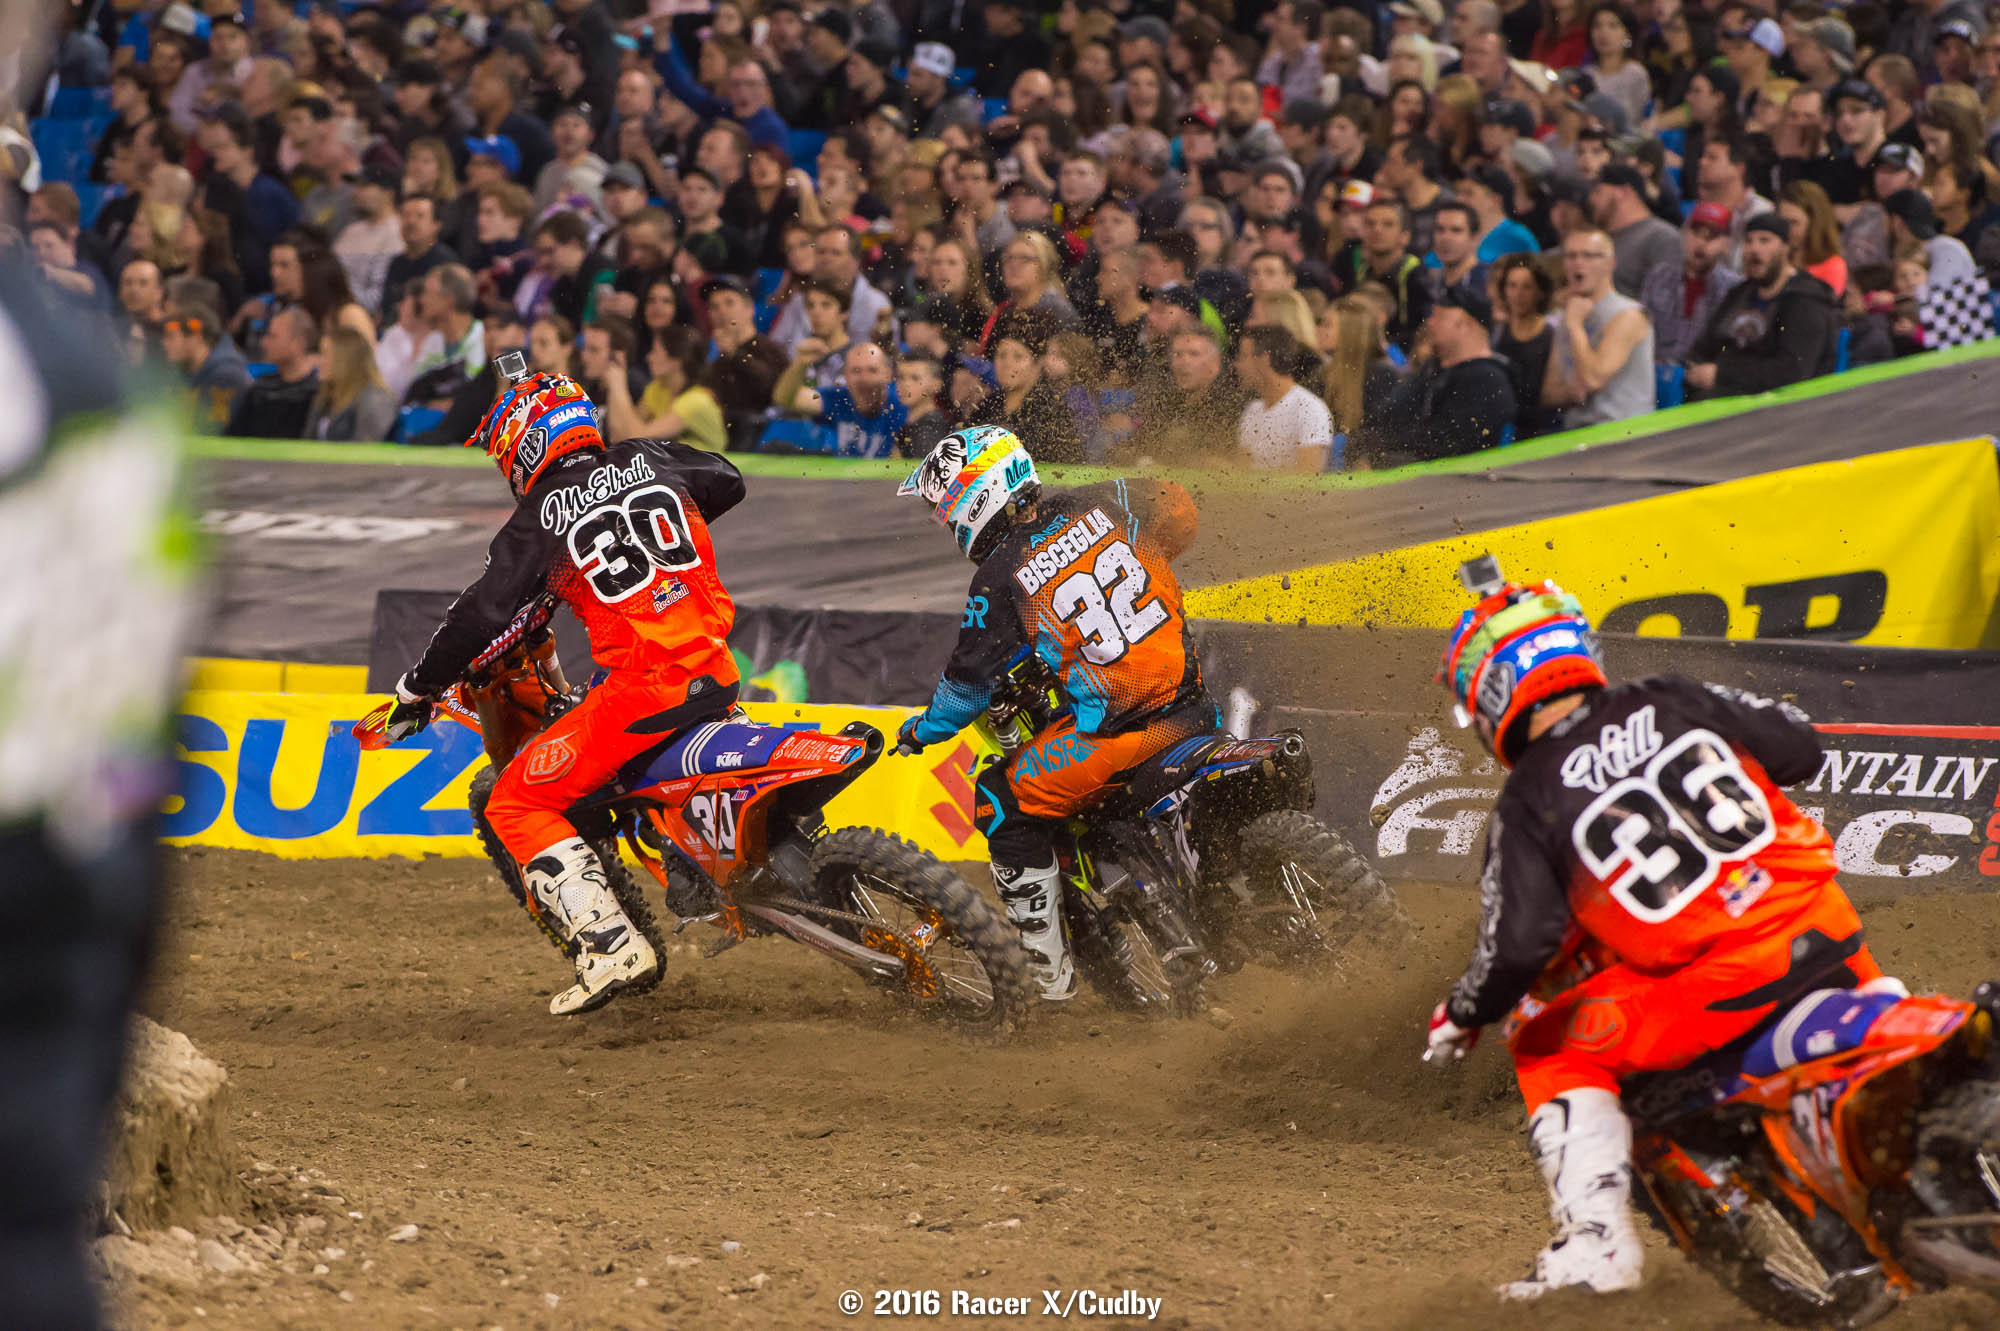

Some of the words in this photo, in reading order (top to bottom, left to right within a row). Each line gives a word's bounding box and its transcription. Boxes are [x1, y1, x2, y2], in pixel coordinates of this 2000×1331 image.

[548, 406, 589, 429] SHANE
[541, 453, 655, 536] McElrath
[567, 485, 702, 604] 30
[1014, 506, 1117, 598] BISCEGLIA
[653, 593, 672, 614] Red
[670, 583, 690, 603] Bull
[1051, 538, 1172, 667] 32
[715, 751, 744, 768] KTM
[1560, 705, 1663, 793] Hill
[691, 792, 736, 851] 30
[1571, 728, 1777, 924] 36
